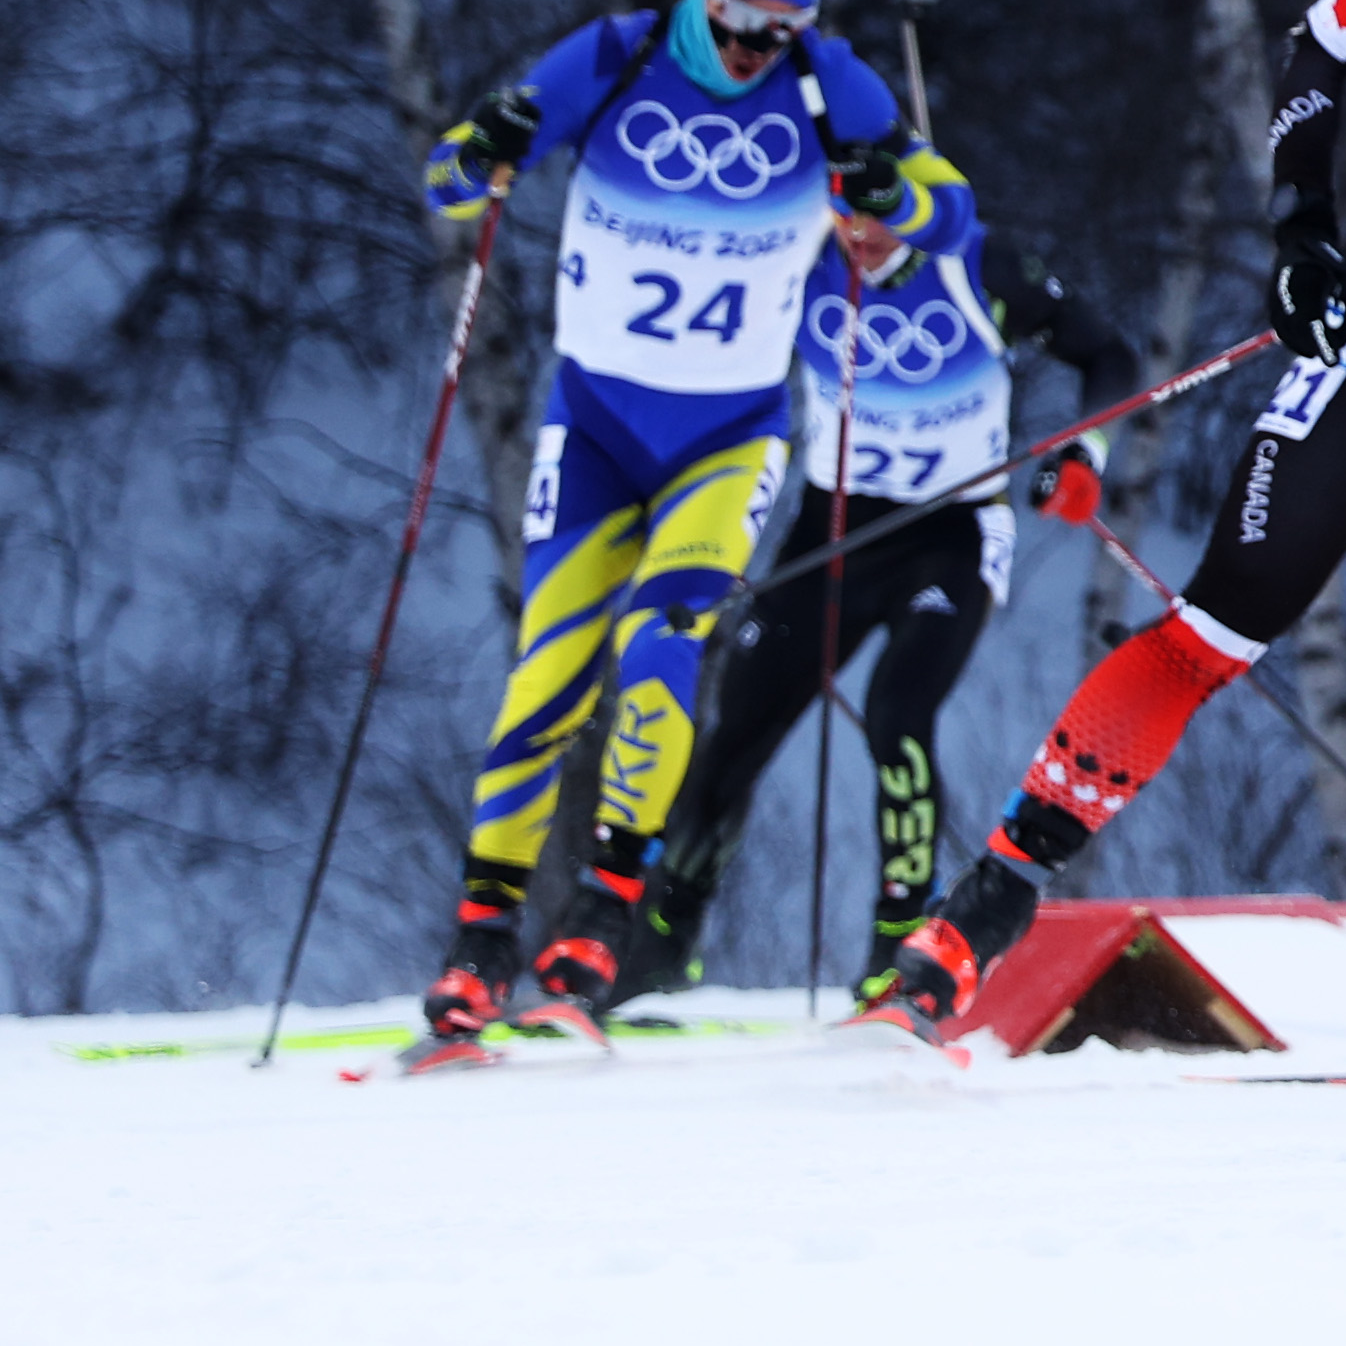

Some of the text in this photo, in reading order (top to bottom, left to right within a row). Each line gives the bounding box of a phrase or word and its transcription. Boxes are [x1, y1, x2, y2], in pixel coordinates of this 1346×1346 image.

[626, 272, 747, 344] 24
[853, 444, 943, 488] 27
[1239, 438, 1280, 544] CANADA
